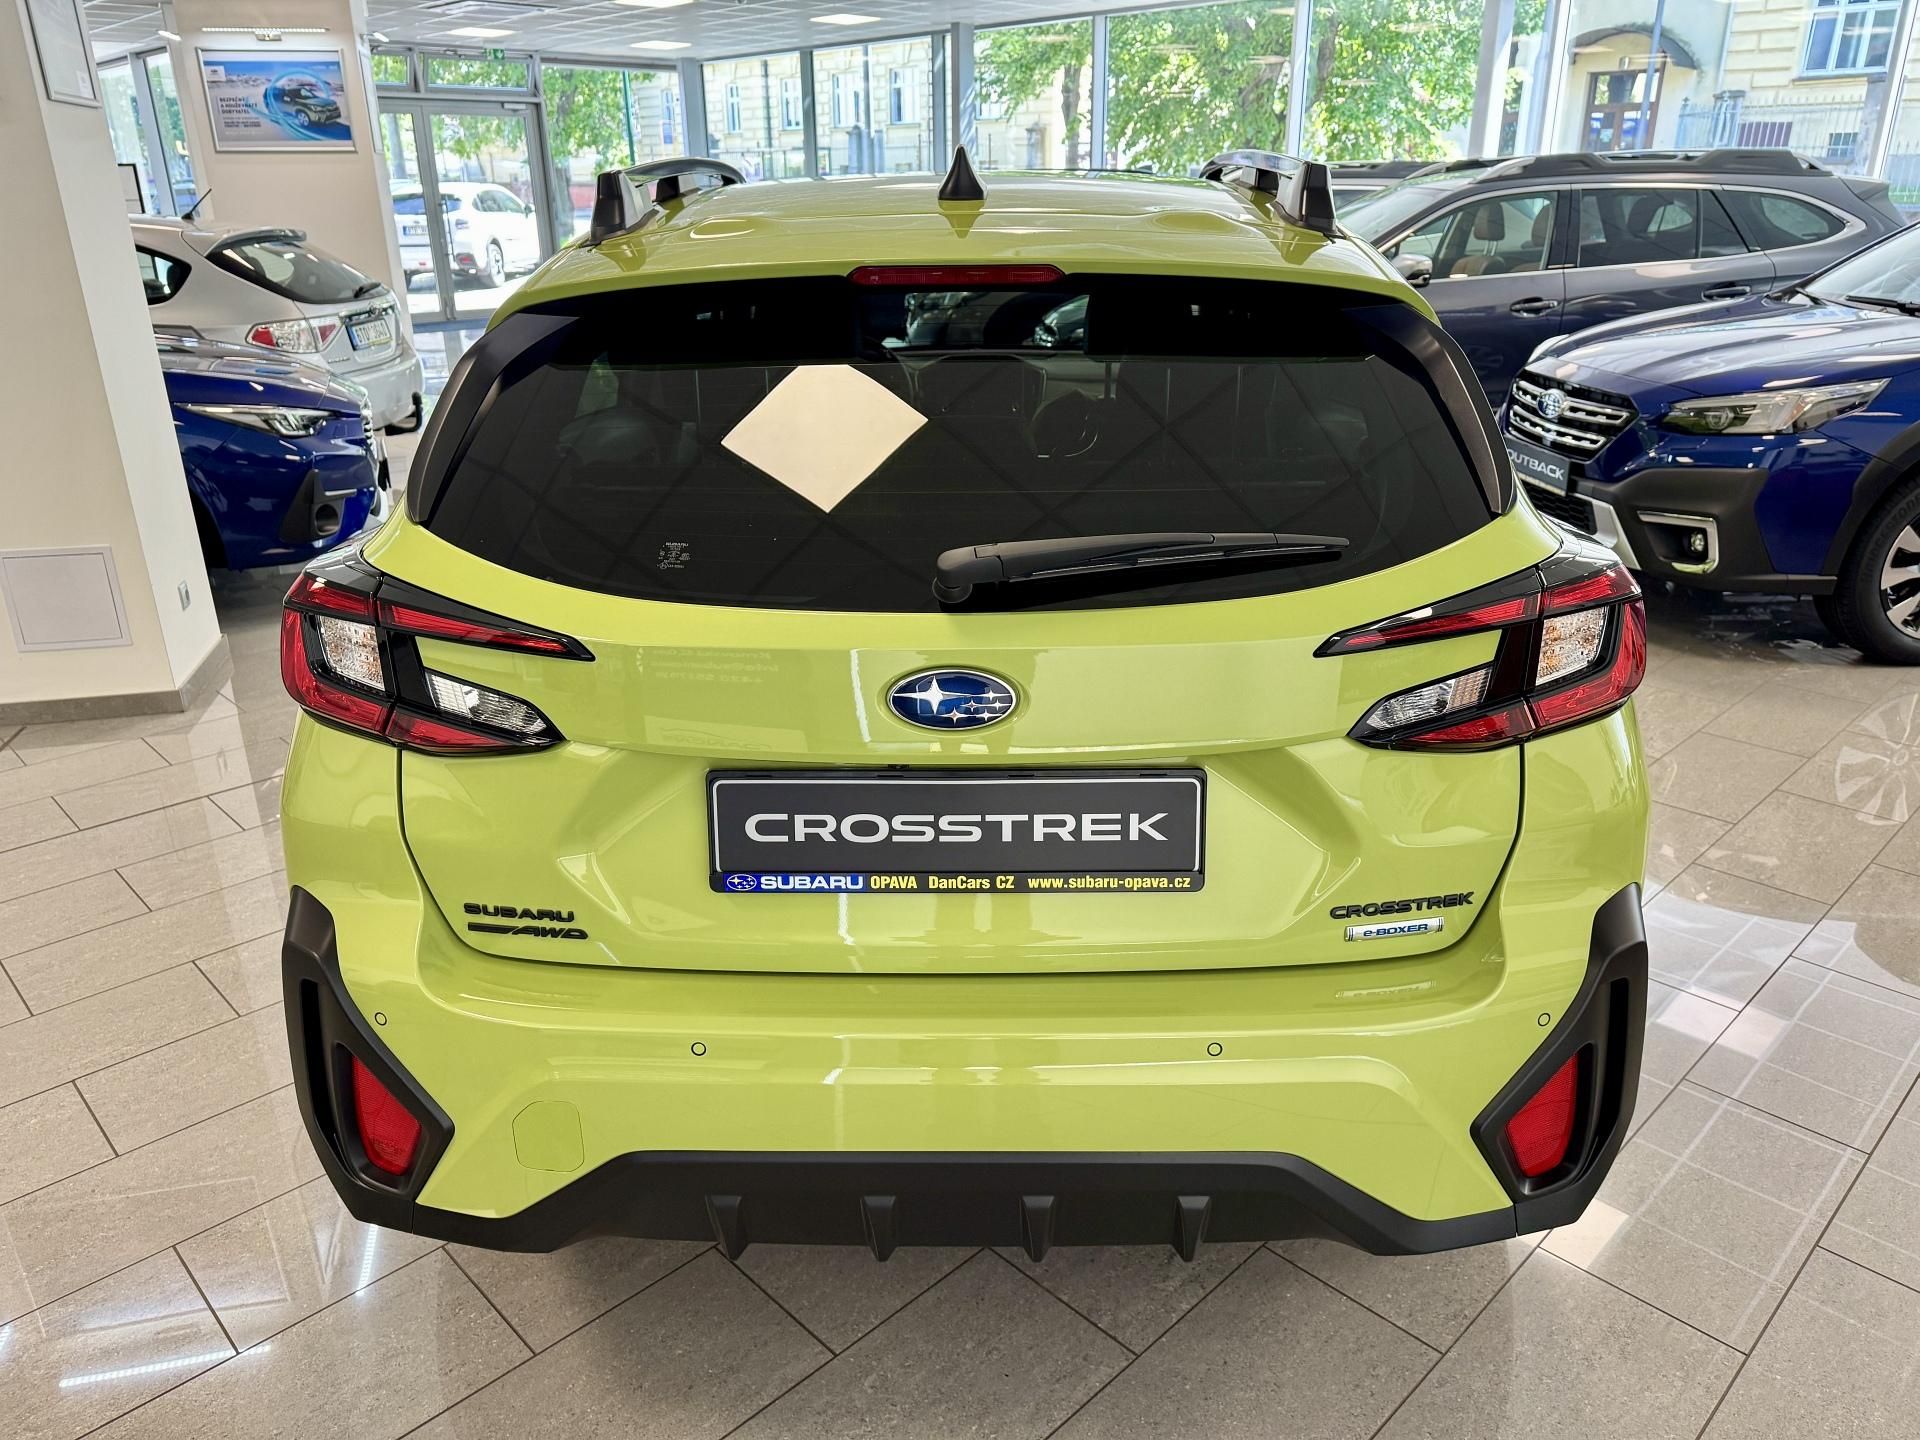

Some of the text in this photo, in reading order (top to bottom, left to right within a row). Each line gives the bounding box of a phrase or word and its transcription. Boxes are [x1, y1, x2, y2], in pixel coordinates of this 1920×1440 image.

[1507, 448, 1565, 481] OUTBACK
[744, 812, 1169, 844] CROSSTREK
[760, 875, 1191, 891] SUBARU OPAVA DanCars CZ www.subaru-opava.cz
[463, 902, 575, 923] SUBARU
[1330, 891, 1475, 920] CROSSTREK
[511, 925, 589, 940] AWD
[1363, 923, 1429, 937] e-BOXER
